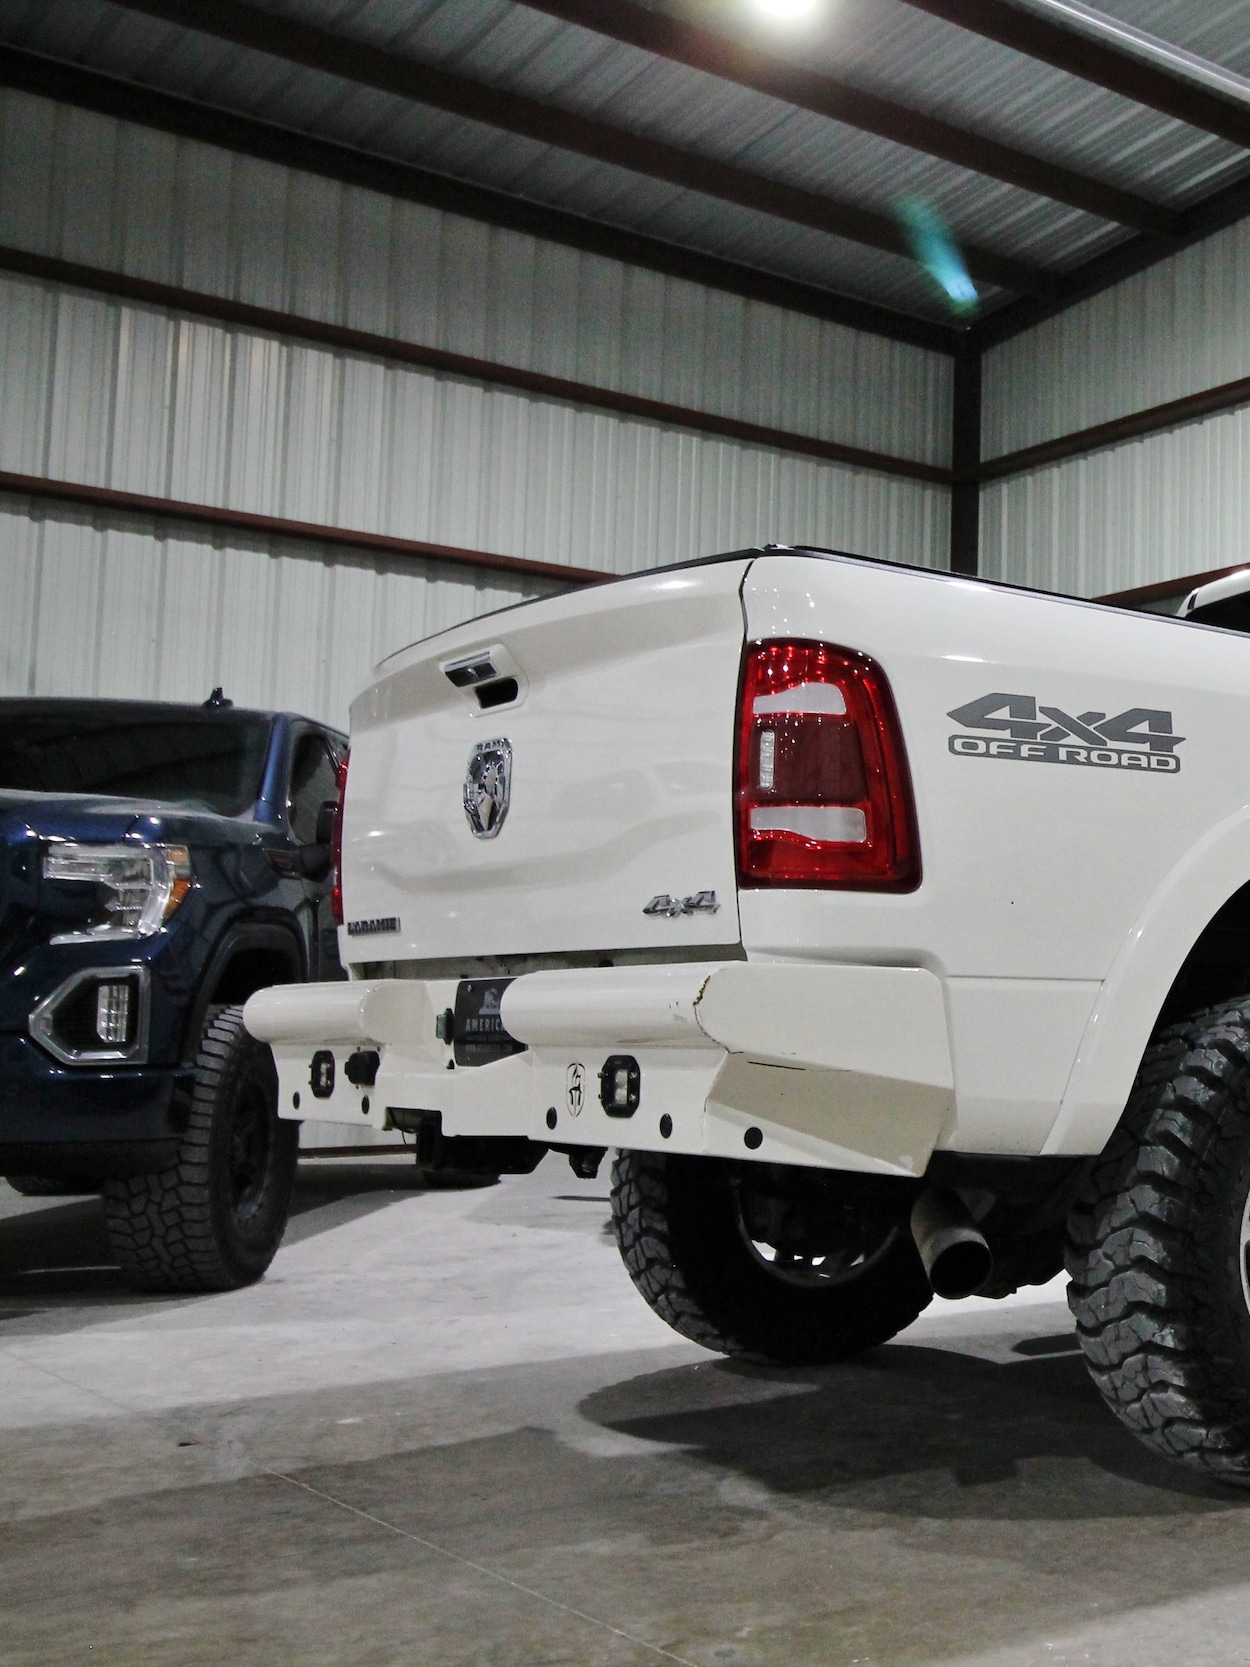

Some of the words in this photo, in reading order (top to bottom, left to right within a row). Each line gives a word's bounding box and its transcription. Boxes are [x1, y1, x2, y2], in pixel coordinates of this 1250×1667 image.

[953, 738, 1048, 758] OFF
[1058, 746, 1177, 771] ROAD
[347, 917, 400, 936] LARAMIE
